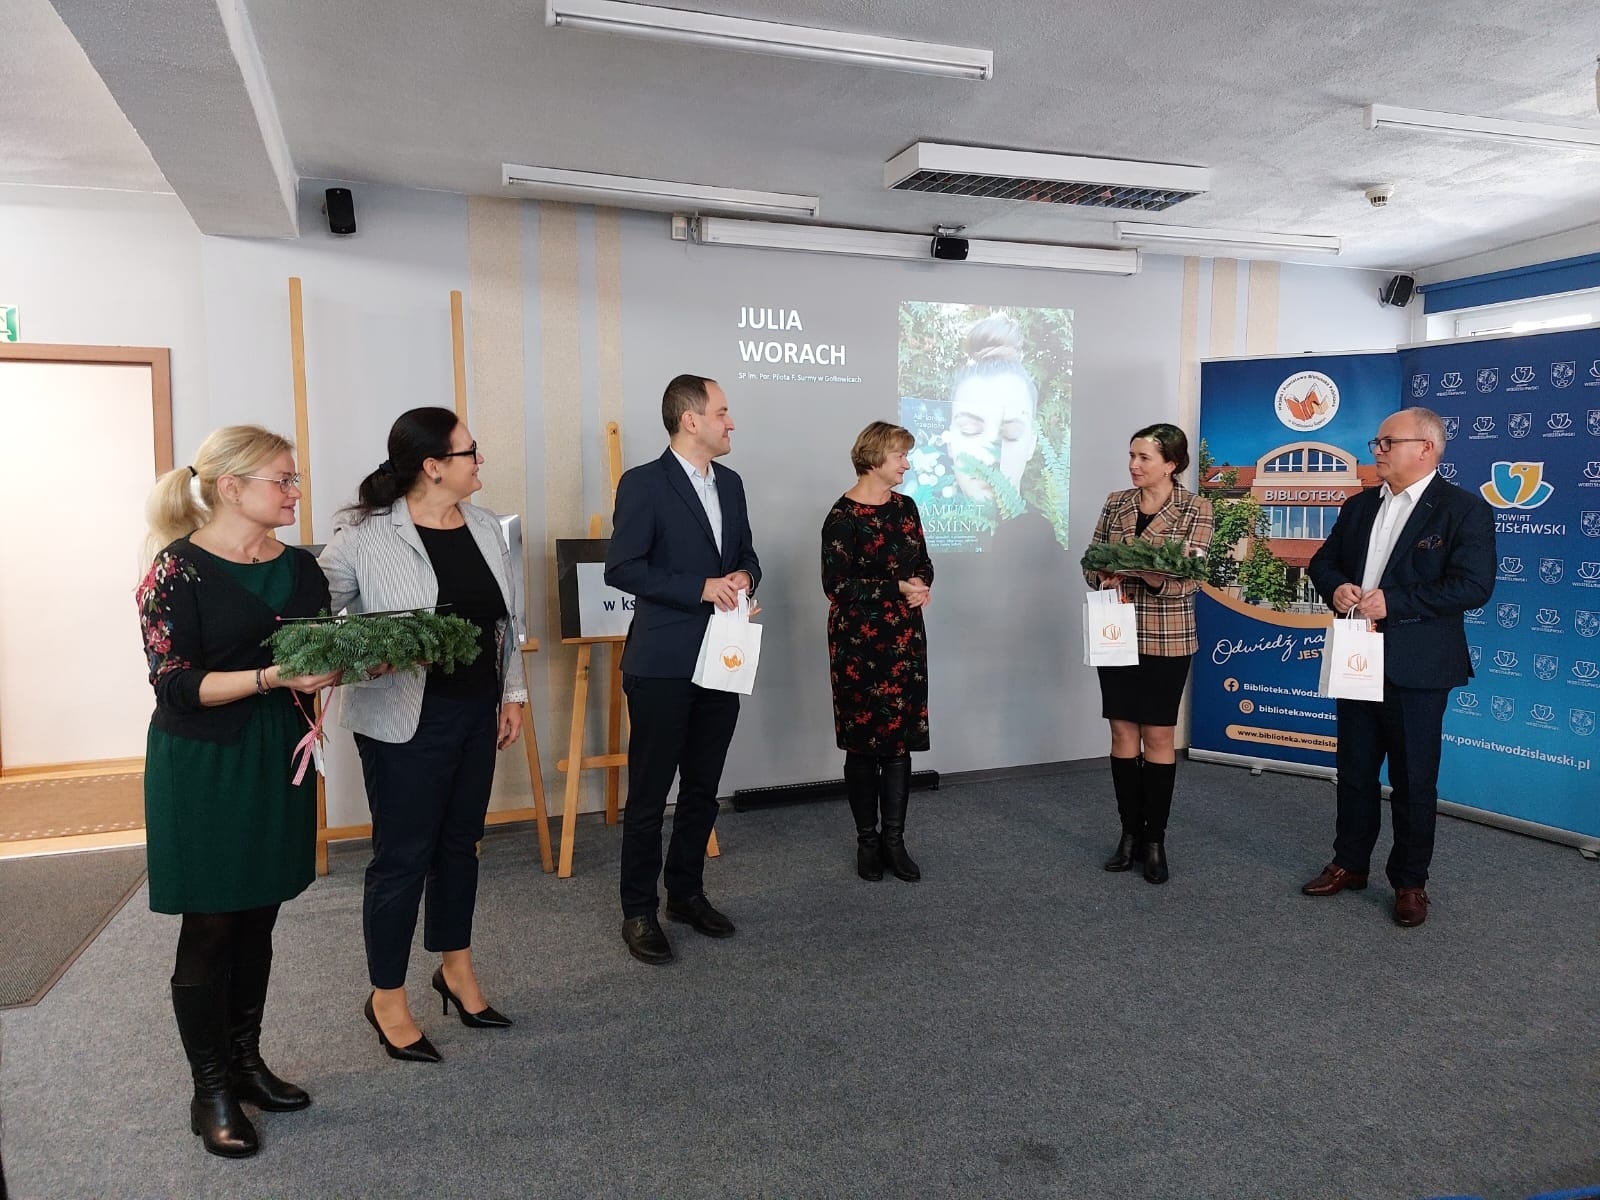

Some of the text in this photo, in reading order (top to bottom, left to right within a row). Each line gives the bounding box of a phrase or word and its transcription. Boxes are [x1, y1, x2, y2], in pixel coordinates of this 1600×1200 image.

[738, 306, 803, 331] JULIA
[739, 340, 846, 365] WORACH
[738, 372, 747, 380] SP
[1264, 489, 1348, 502] BIBLIOTEKA
[1496, 513, 1533, 522] POWIAT
[1494, 522, 1566, 536] ZISŁAWSKI
[603, 596, 636, 611] w ks
[1212, 633, 1326, 665] Odwiedź na
[1297, 648, 1325, 660] JEST
[1243, 683, 1330, 699] Biblioteka.Wodz
[1258, 704, 1337, 721] bibliotekawodzis
[1237, 729, 1338, 749] www.biblioteka.wodzisla
[1441, 732, 1591, 771] w.powiatwodzislawski.pl
